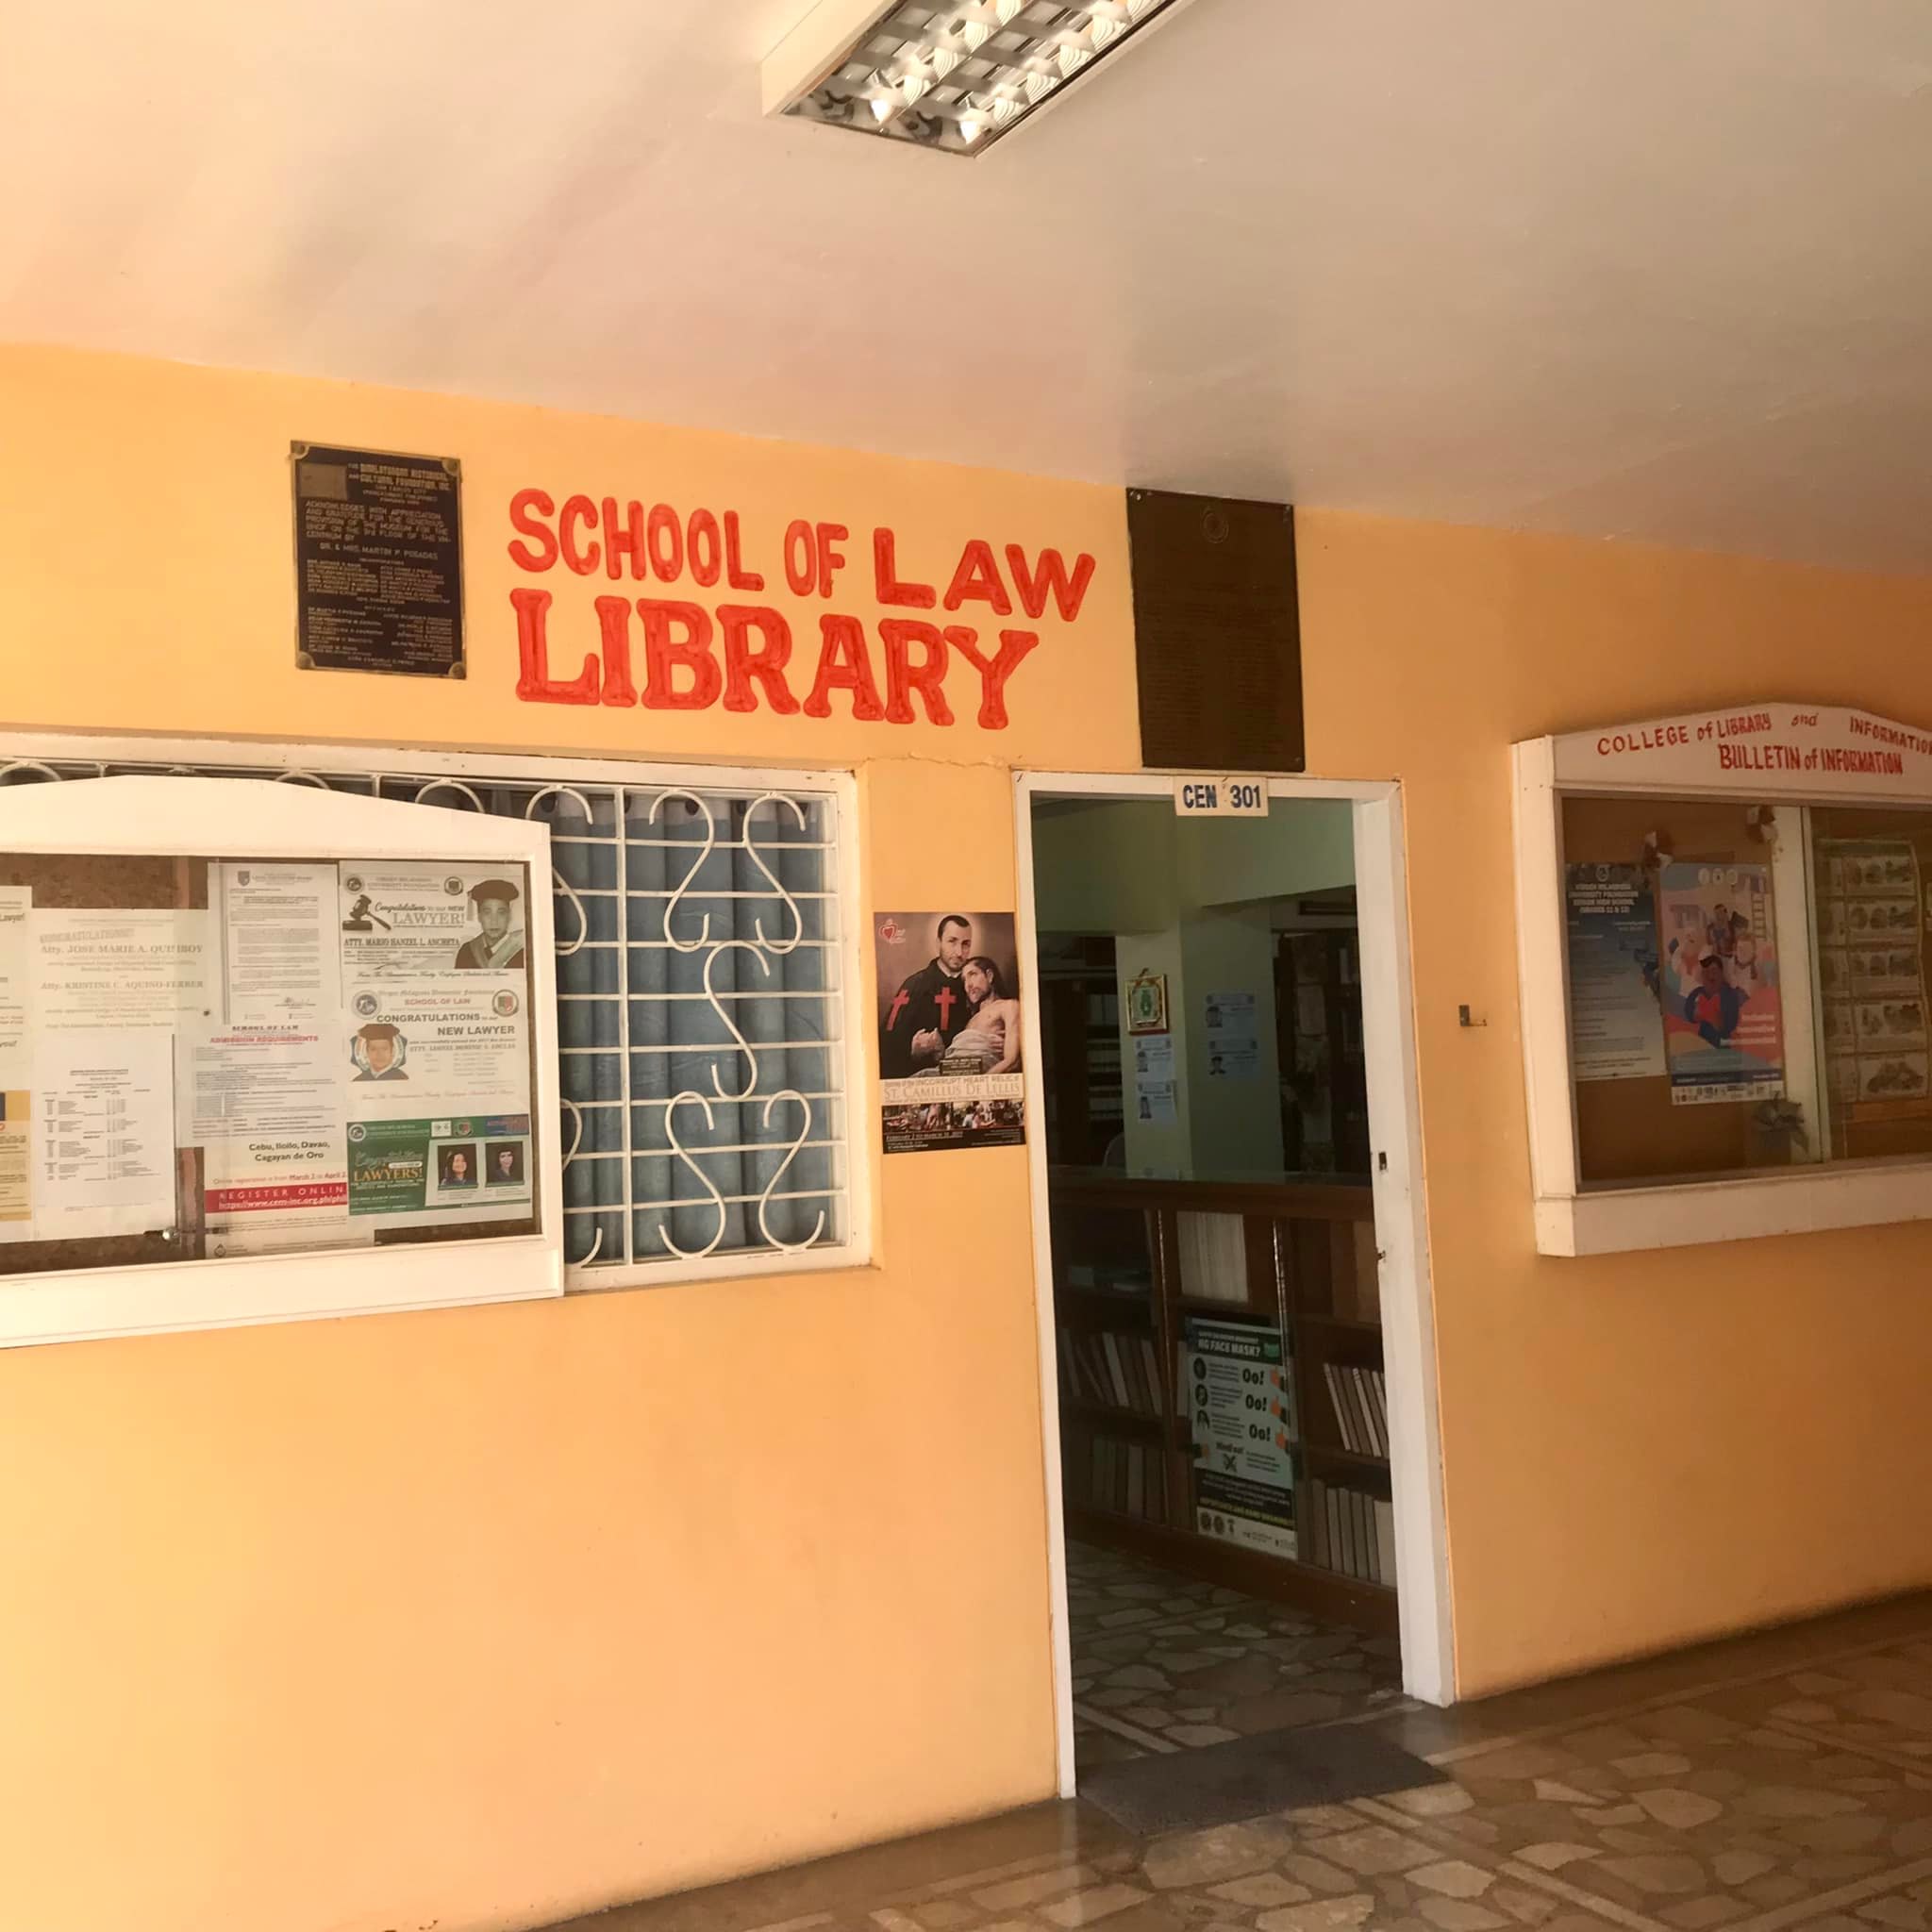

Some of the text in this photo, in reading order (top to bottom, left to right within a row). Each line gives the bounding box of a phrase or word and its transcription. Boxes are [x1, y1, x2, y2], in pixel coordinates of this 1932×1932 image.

[508, 488, 765, 592] SCHOOL
[783, 519, 849, 599] OF
[873, 526, 1097, 623] LAW
[508, 588, 1040, 730] LIBRARY
[1596, 724, 1690, 756] COLLEGE
[1696, 720, 1714, 741] of
[1717, 712, 1773, 740] LIBRARY
[1790, 712, 1820, 727] and
[1718, 743, 1904, 774] BULLETIN of INFORMATION
[1183, 784, 1262, 808] CEN 301
[392, 912, 466, 924] LAWYER!
[405, 998, 439, 1007] SCHOOL
[376, 1012, 480, 1024] CONGRATULATIONS
[437, 1025, 515, 1036] NEW LAWYER
[248, 1142, 275, 1152] Cebu,
[301, 1141, 331, 1149] Davao,
[255, 1153, 291, 1163] Cagayan
[306, 1151, 325, 1159] Oro
[354, 1168, 424, 1182] LAWYERS!
[219, 1189, 289, 1200] REGISTER
[1209, 1341, 1230, 1353] FACE
[1231, 1342, 1261, 1357] MASK?
[1242, 1368, 1265, 1386] Oo!
[1245, 1394, 1268, 1412] Oo!
[1248, 1424, 1272, 1442] Oo!
